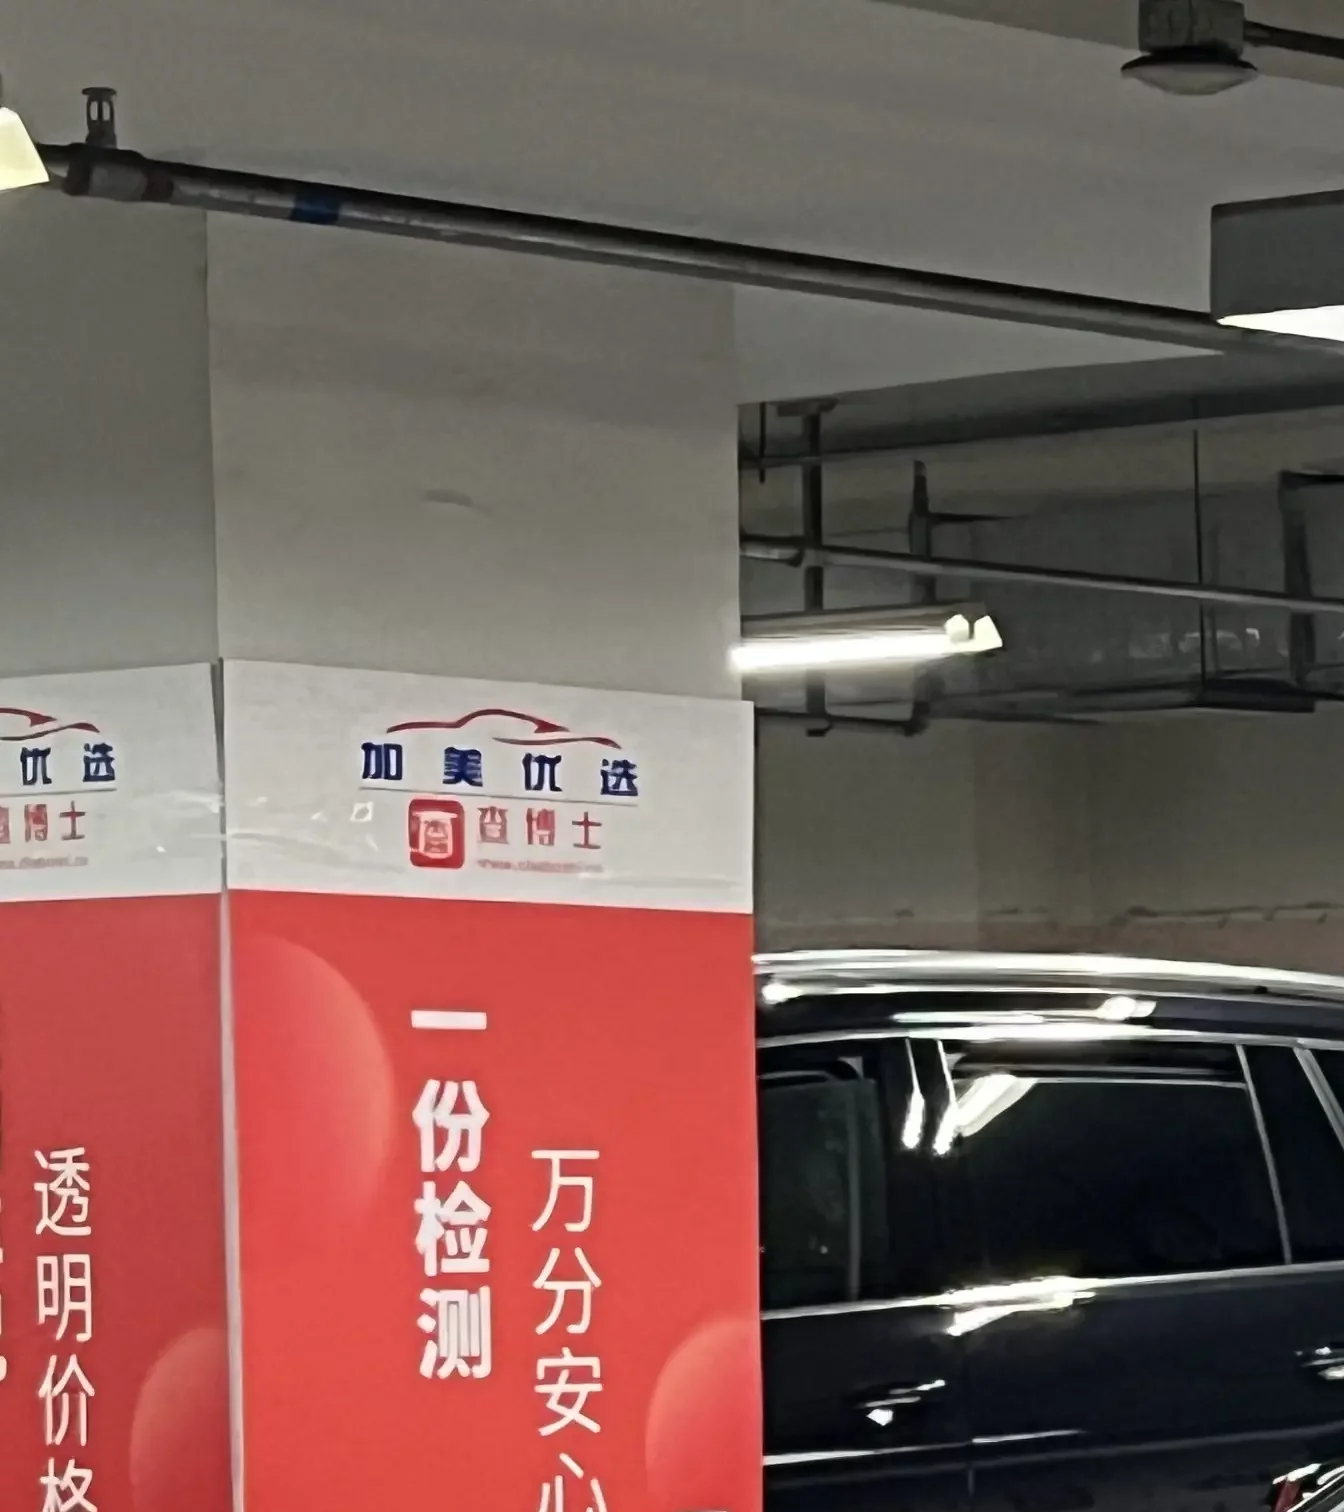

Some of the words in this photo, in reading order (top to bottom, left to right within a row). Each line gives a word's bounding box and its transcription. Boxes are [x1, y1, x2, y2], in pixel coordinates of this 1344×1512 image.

[361, 742, 638, 796] 加美优选
[411, 1009, 491, 1379] 一份检测
